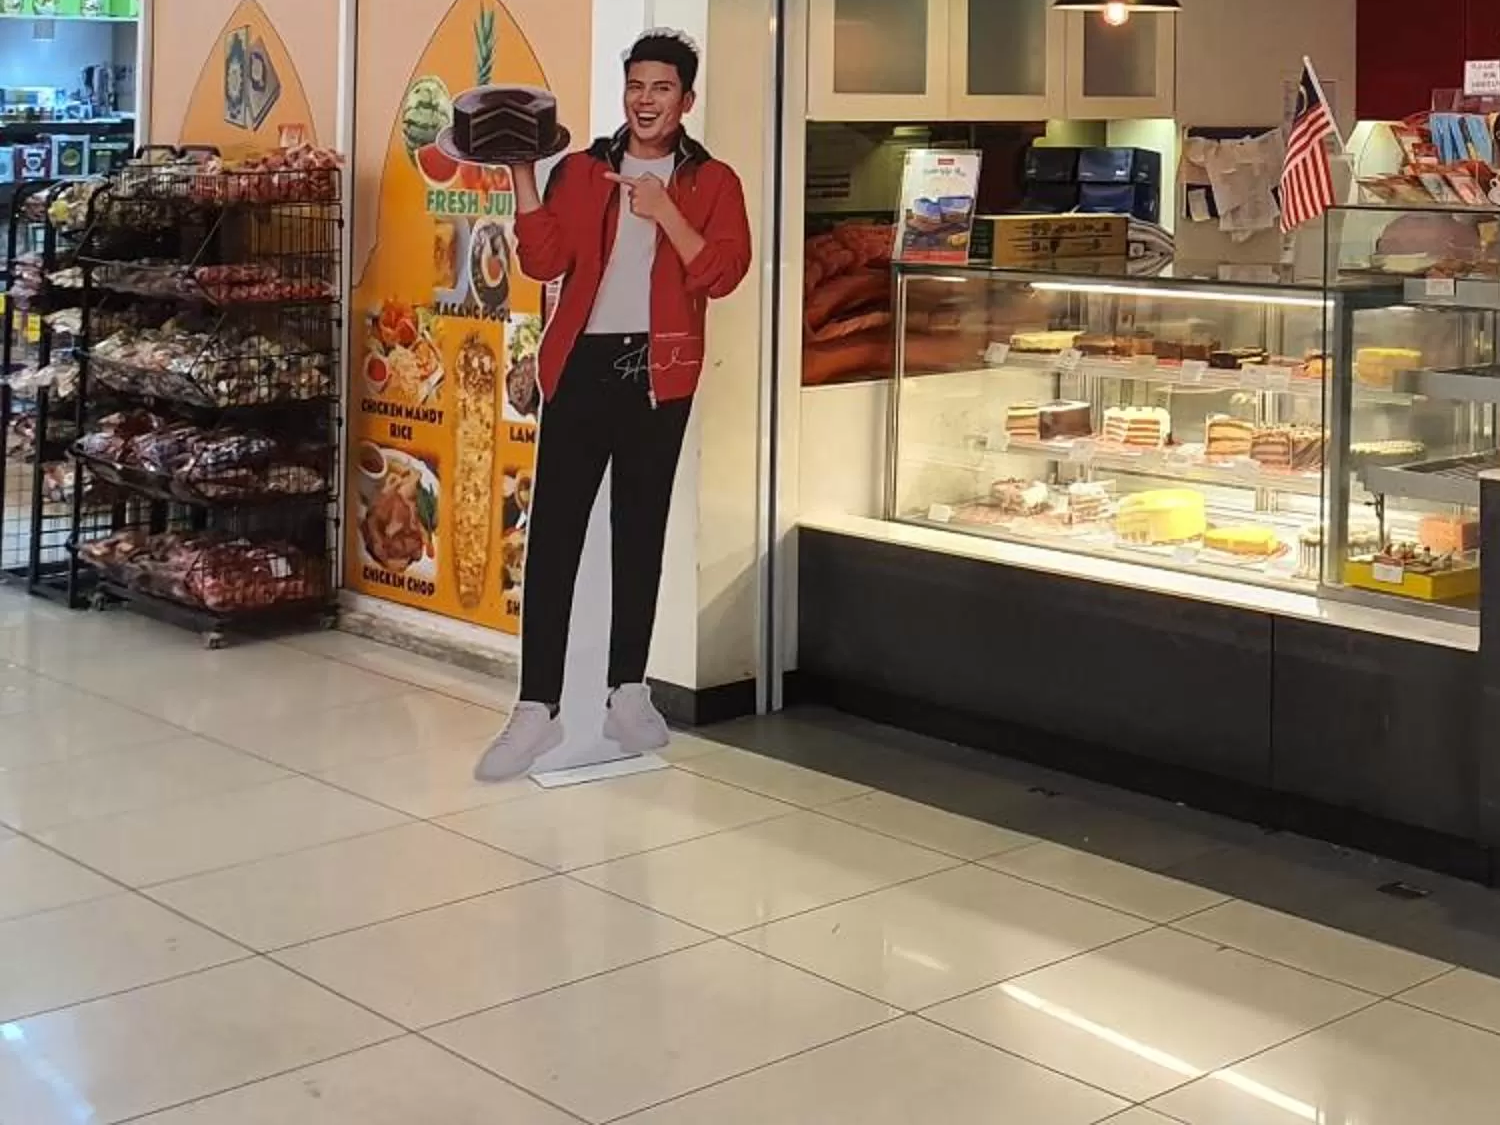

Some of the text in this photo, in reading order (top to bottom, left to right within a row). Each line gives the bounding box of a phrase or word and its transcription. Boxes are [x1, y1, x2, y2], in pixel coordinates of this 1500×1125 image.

[426, 190, 480, 213] FRESH
[362, 398, 403, 417] CHICKEN
[390, 422, 412, 441] RICE
[363, 567, 435, 596] CHICKEN CHOP
